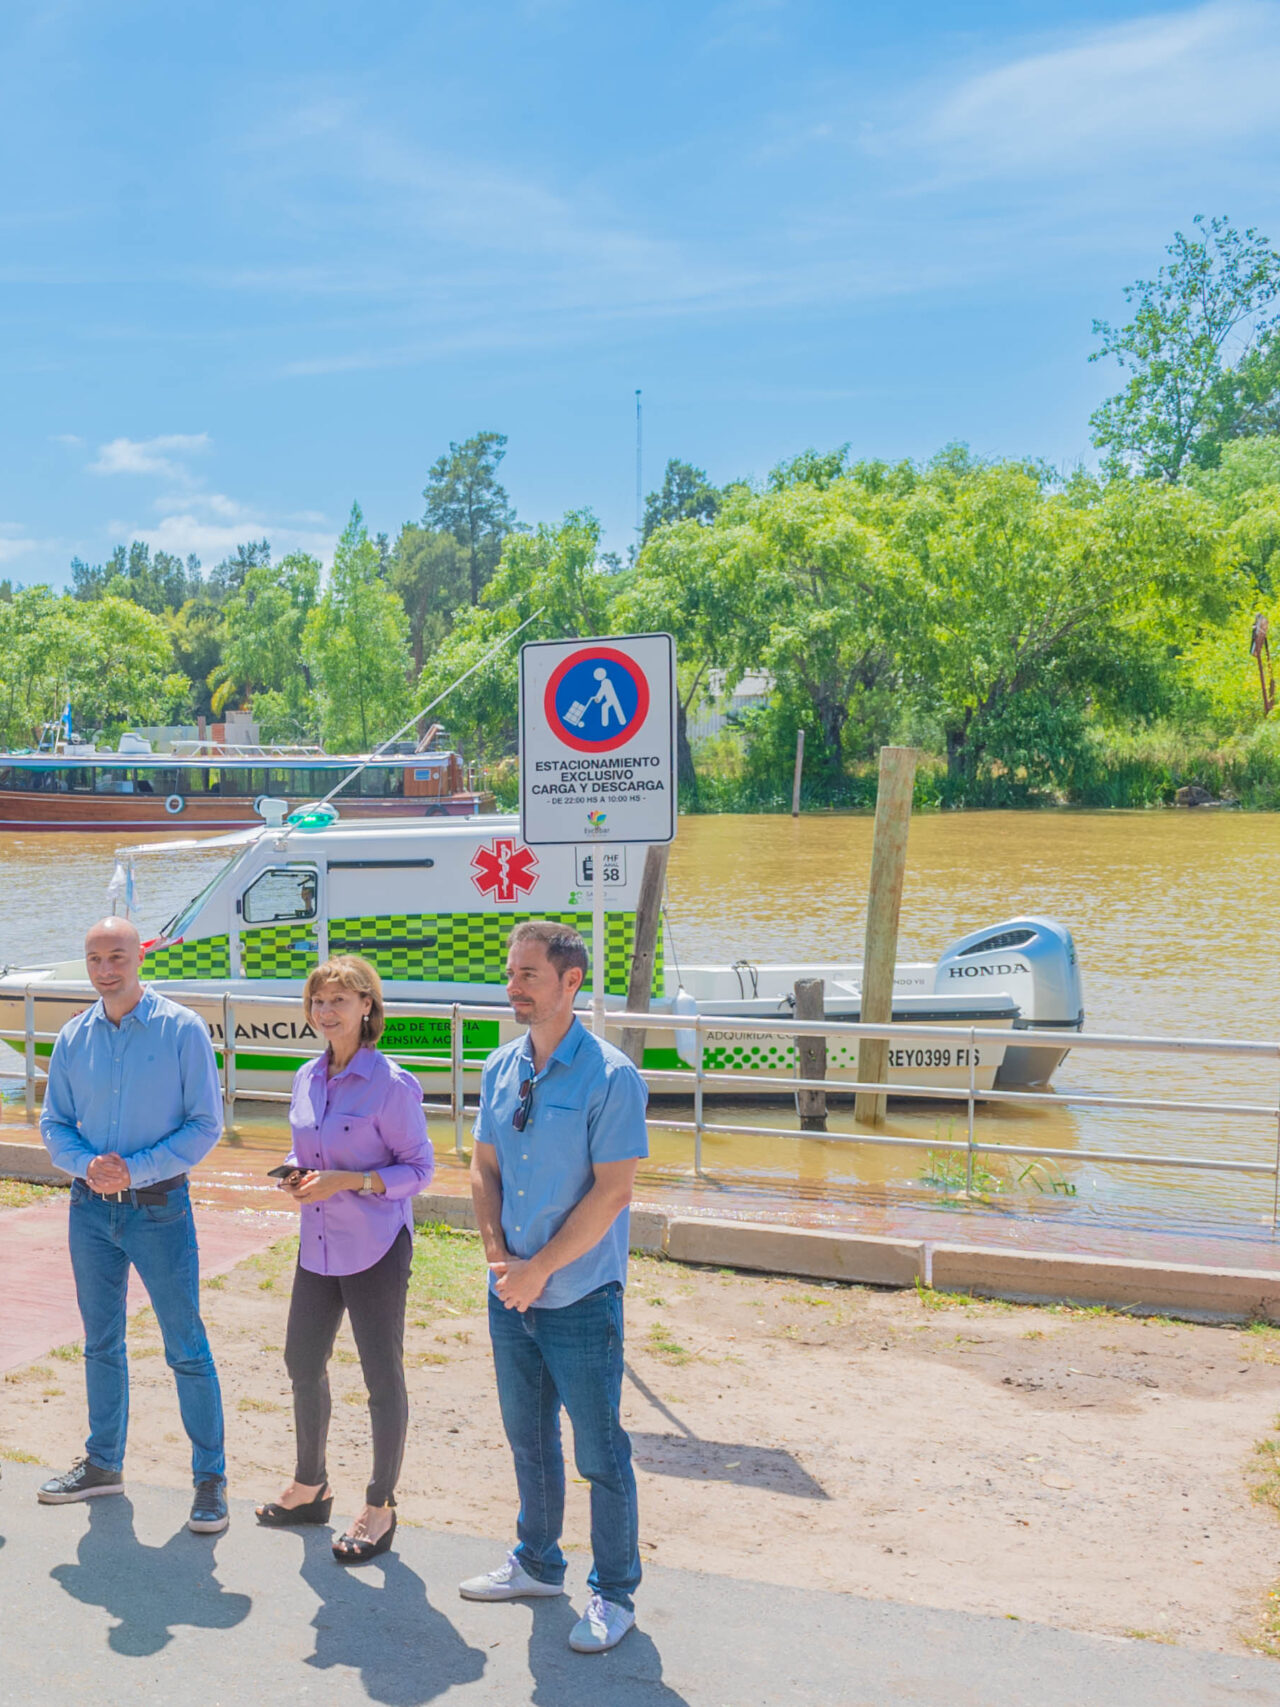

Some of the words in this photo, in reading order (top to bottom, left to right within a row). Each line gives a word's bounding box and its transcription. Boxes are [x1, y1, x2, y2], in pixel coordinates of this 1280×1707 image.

[535, 757, 660, 771] ESTACIONAMIENTO
[561, 769, 634, 782] EXCLUSIVO
[531, 784, 577, 795] CARGA
[579, 783, 589, 793] Y
[592, 780, 664, 793] DESCARGA
[551, 797, 563, 805] DE
[586, 796, 598, 804] HS
[608, 795, 628, 803] 10:00
[629, 794, 641, 802] HS
[949, 963, 1031, 978] HONDA
[409, 1022, 425, 1031] DE
[429, 1021, 480, 1031] TERPIA
[432, 1035, 472, 1044] MOIL
